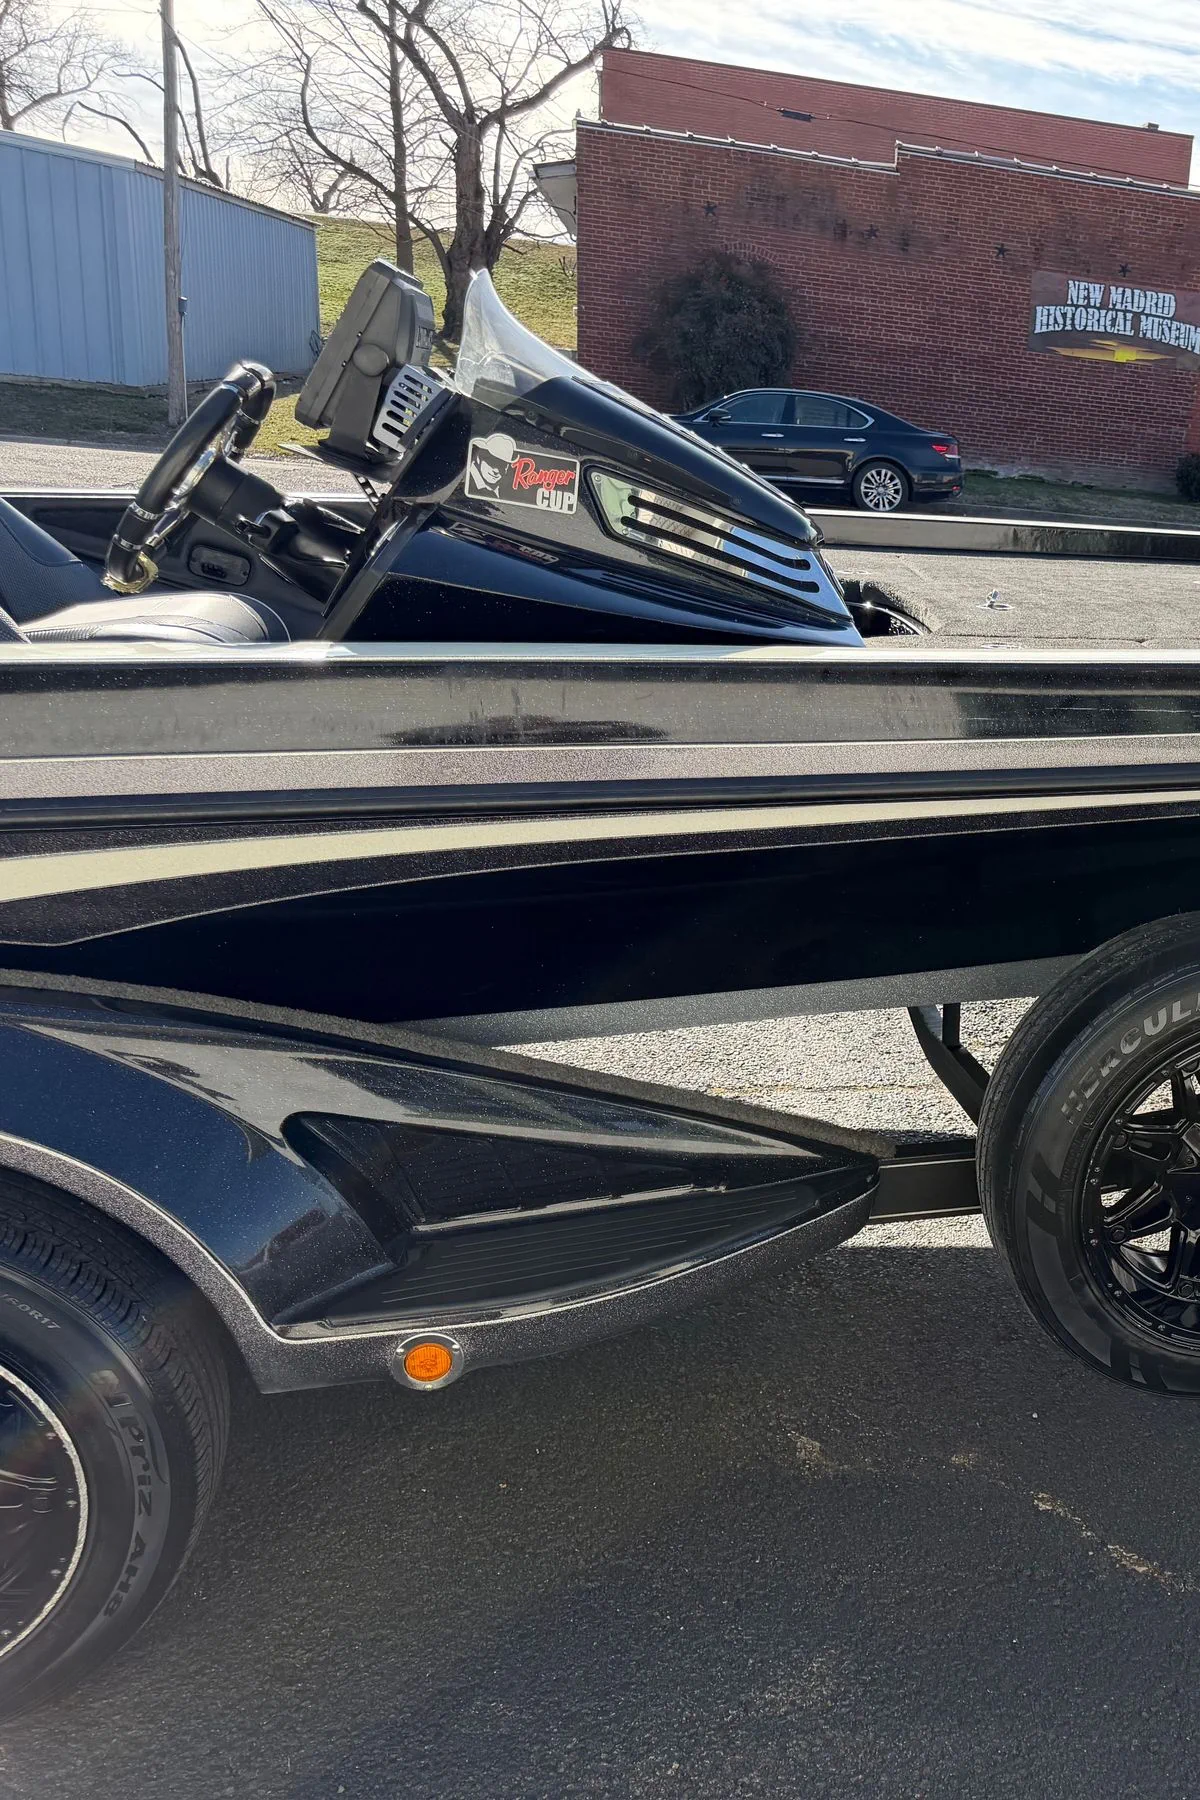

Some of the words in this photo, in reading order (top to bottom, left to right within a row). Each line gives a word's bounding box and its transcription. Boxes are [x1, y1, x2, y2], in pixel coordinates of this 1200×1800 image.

[1066, 280, 1105, 307] NEW
[1108, 285, 1176, 318] MADRID
[1033, 305, 1135, 336] HISTORICAL
[511, 458, 575, 491] Ranger
[536, 488, 576, 511] CUP
